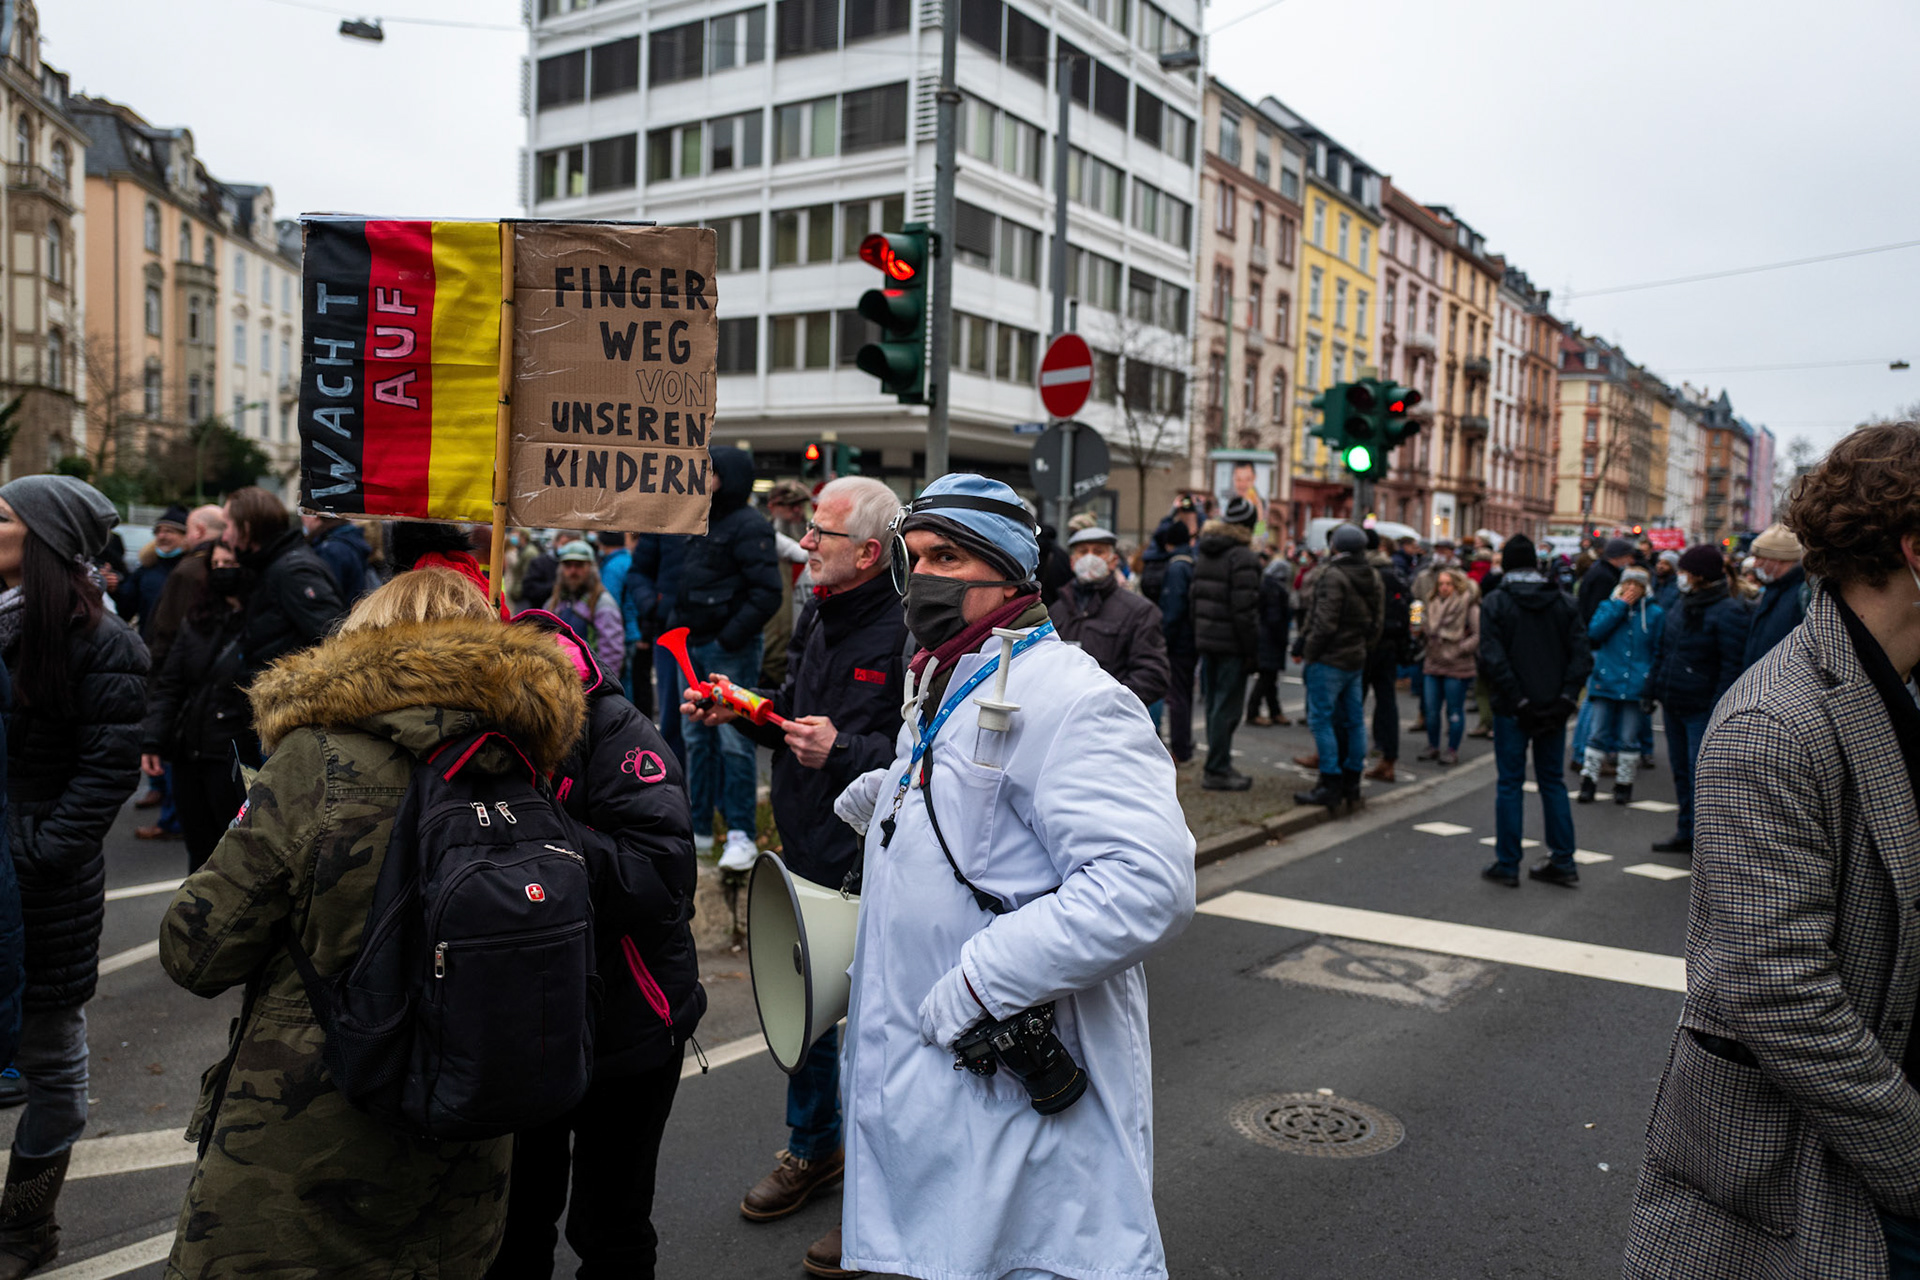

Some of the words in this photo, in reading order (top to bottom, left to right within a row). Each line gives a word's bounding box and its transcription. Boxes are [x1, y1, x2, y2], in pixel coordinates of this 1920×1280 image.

[555, 265, 709, 310] FINGER
[373, 286, 419, 410] AUF
[600, 320, 691, 364] WEG
[311, 282, 359, 499] WACHT
[636, 368, 708, 407] VON
[551, 401, 706, 447] UNSEREN
[544, 448, 708, 496] KINDERN
